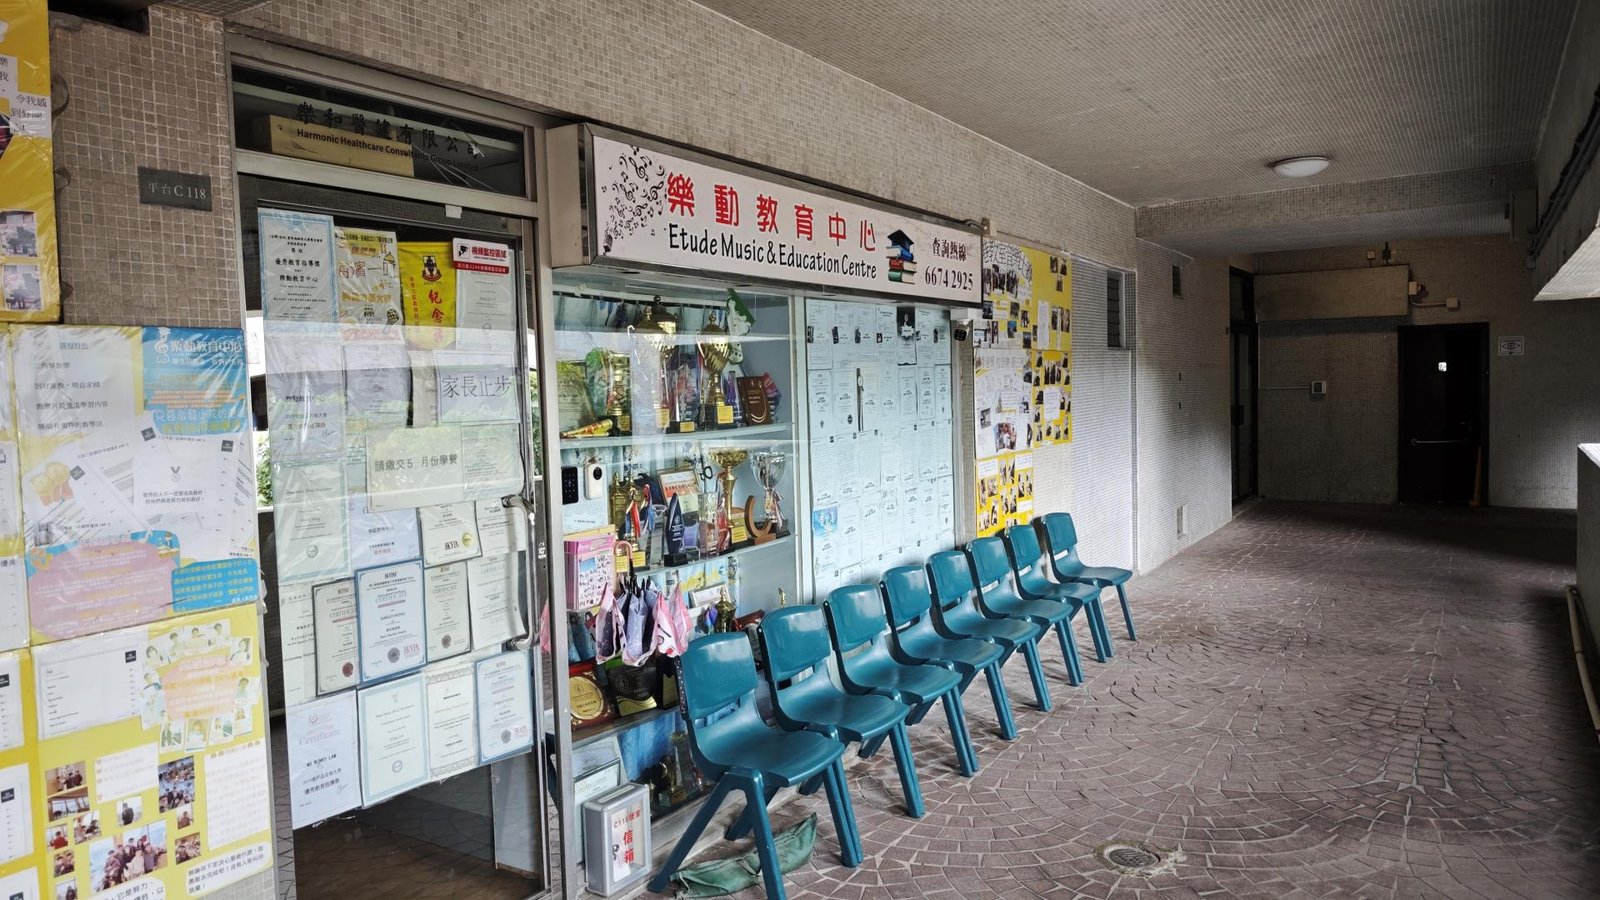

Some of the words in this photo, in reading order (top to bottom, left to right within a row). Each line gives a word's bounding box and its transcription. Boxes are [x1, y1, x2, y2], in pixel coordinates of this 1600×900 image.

[297, 128, 339, 149] Harmonic
[340, 136, 384, 157] Healthcare
[385, 145, 429, 162] Consultants
[667, 172, 876, 252] 樂動教育中心
[669, 222, 718, 256] Etude
[721, 232, 764, 263] Music
[778, 243, 840, 274] Education
[841, 253, 877, 280] Centre
[932, 235, 967, 262] 查詢熱線
[925, 265, 949, 287] 6674
[951, 270, 973, 291] 2925
[441, 375, 511, 405] 家長止步
[623, 829, 634, 865] 信箱
